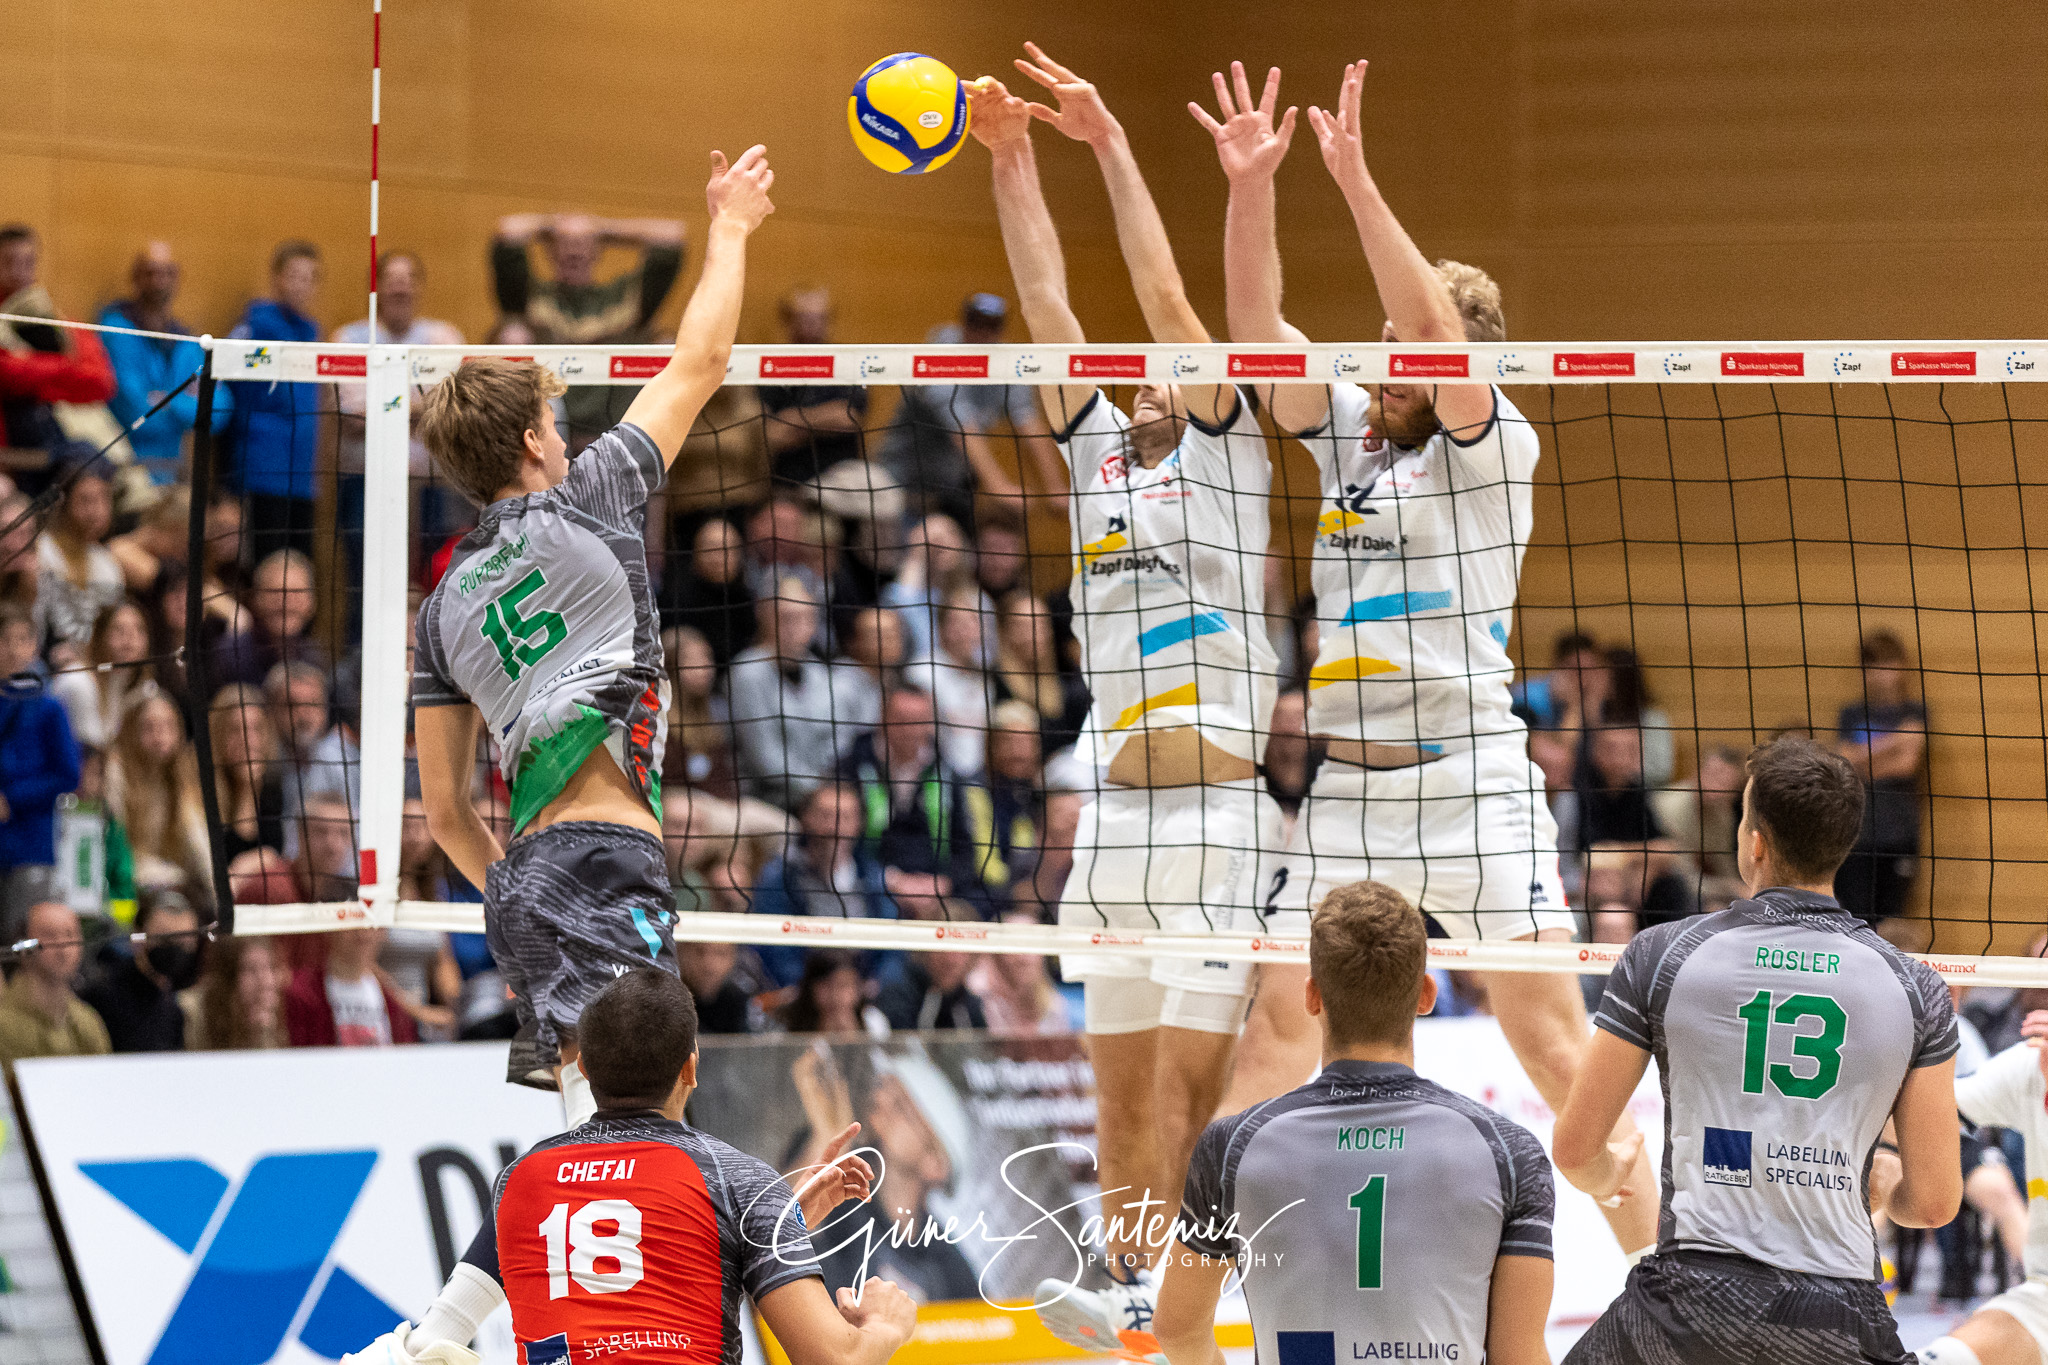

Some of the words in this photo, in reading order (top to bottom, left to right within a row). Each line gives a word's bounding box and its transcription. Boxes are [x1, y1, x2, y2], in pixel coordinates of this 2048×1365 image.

[868, 365, 886, 374] Zapf
[1023, 365, 1041, 374] Zapf
[1181, 364, 1199, 374] Zapf
[1342, 363, 1360, 373] Zapf
[1505, 364, 1524, 373] Zapf
[1570, 362, 1599, 372] Sparkasse
[1600, 362, 1630, 373] Nürnberg
[1672, 363, 1691, 373] Zapf
[1738, 362, 1768, 372] Sparkasse
[1769, 361, 1799, 373] Nürnberg
[1842, 362, 1861, 373] Zapf
[1909, 362, 1940, 372] Sparkasse
[1940, 361, 1970, 372] Nürnberg
[2014, 361, 2035, 371] Zapf
[1090, 557, 1121, 576] Zapf
[479, 565, 570, 682] 15
[1591, 951, 1622, 962] Mar
[1754, 943, 1841, 975] RÖSLER
[1931, 961, 1976, 974] Marmot
[1736, 988, 1849, 1101] 13
[1329, 1083, 1366, 1097] local
[1369, 1086, 1421, 1098] heroes
[1336, 1126, 1405, 1151] KOCH
[1767, 1142, 1851, 1168] LABELLIN
[557, 1158, 636, 1183] CHEFAI
[1347, 1173, 1388, 1291] 1
[538, 1198, 644, 1300] 18
